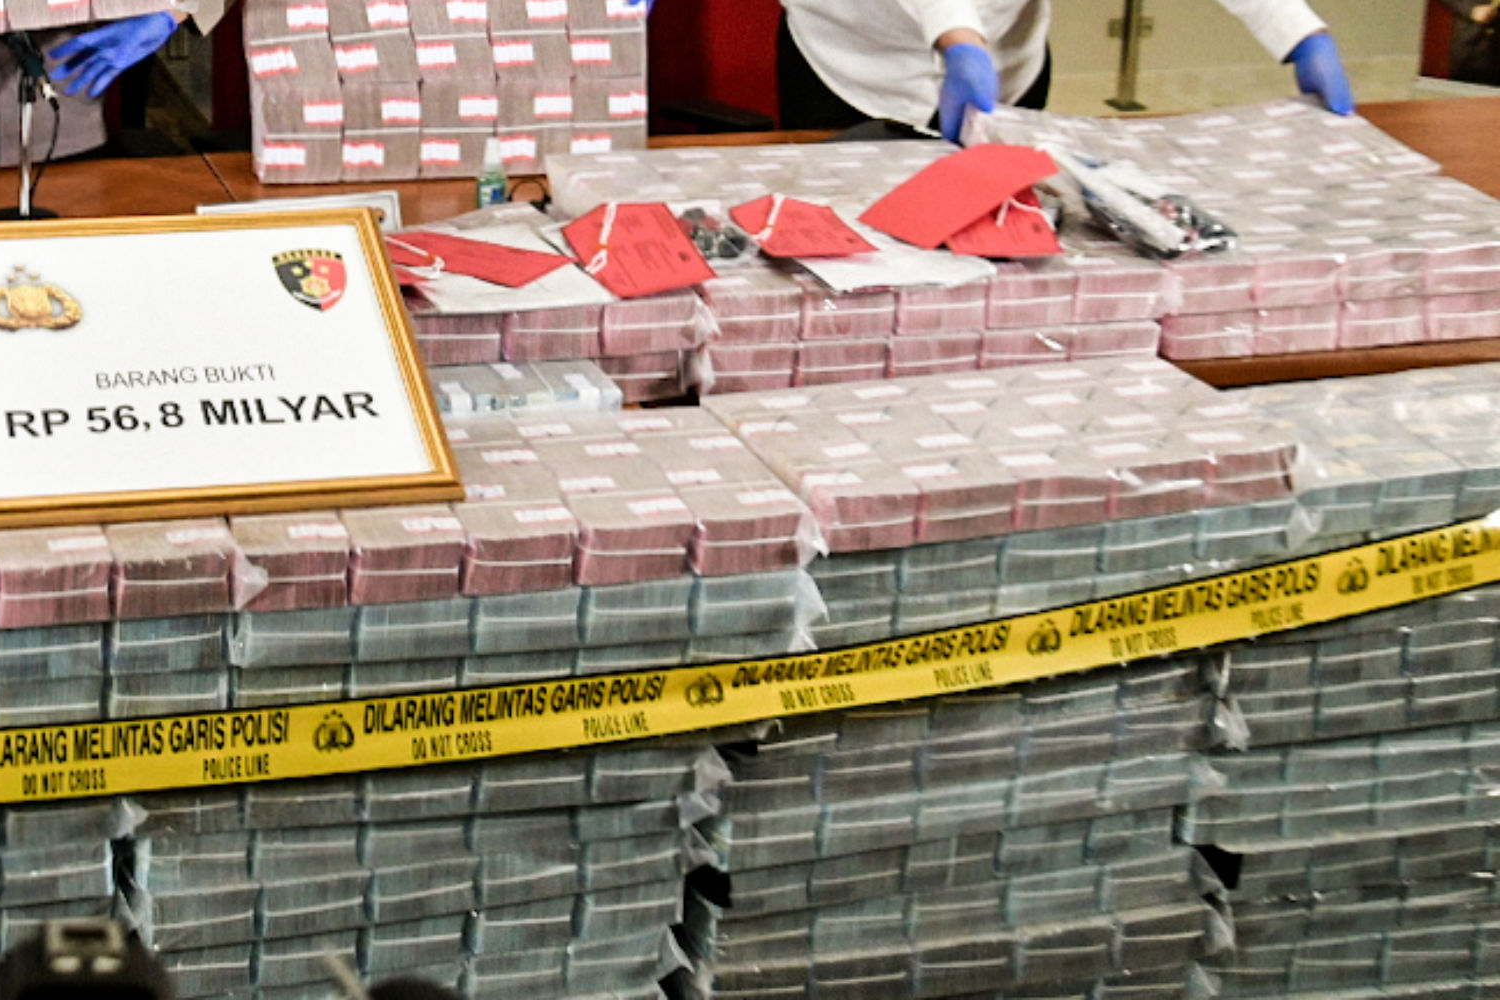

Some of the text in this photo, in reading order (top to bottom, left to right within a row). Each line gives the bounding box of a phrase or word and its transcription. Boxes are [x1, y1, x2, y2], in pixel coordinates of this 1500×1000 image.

[95, 365, 276, 390] BARANG BUKTI
[5, 408, 70, 438] RP
[200, 391, 380, 426] MILYAR
[1070, 562, 1319, 636] DILARANG MELINTAS GARIS POLISI
[732, 625, 1010, 689] DILARANG MELINTAS GARIS POLISI
[934, 660, 994, 689] POLICE LINE
[363, 675, 666, 735] DILARANG MELINTAS GARIS POLISI
[73, 722, 164, 762] MELINTAS
[169, 716, 225, 754] GARIS
[231, 712, 290, 749] POLISI
[582, 712, 649, 739] POLICE LINE
[412, 730, 492, 760] DO NOT CROSS
[22, 768, 106, 796] DO NOT CROSS
[202, 755, 270, 780] POLICE LINE
